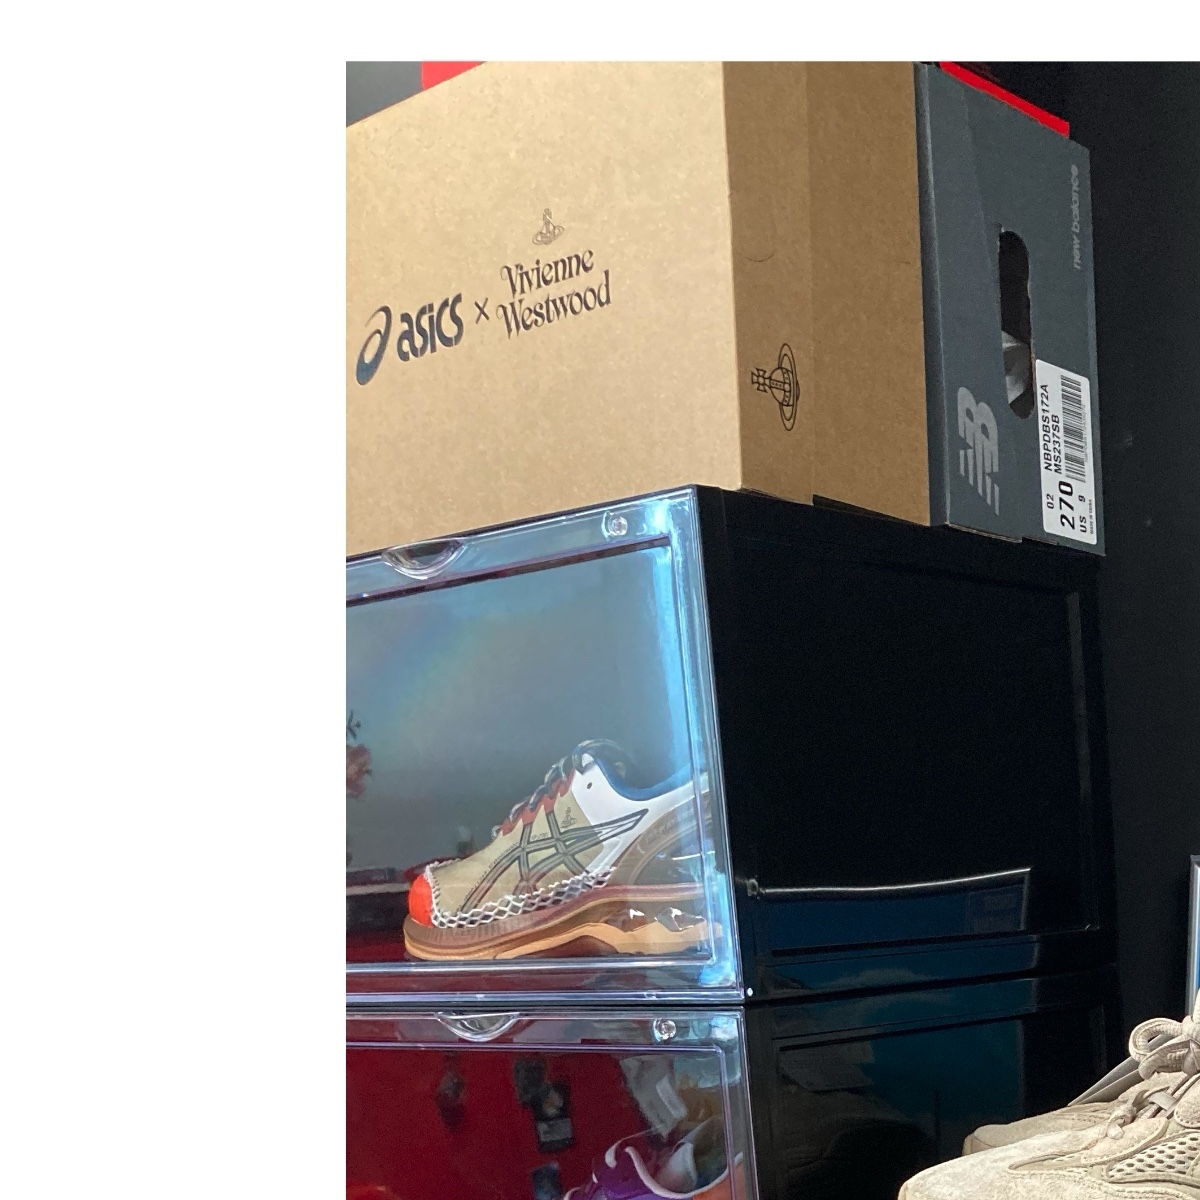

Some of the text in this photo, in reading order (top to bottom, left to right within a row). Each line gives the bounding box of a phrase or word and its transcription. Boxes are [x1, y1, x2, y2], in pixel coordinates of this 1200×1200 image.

[1070, 164, 1081, 270] new balance
[501, 249, 594, 299] Vivienne
[496, 270, 612, 340] Westwood
[1040, 384, 1053, 472] NBPDBS172A
[1051, 413, 1062, 475] MS237SB
[1046, 493, 1055, 509] 02
[1058, 480, 1075, 530] 270
[1077, 494, 1087, 533] US 9
